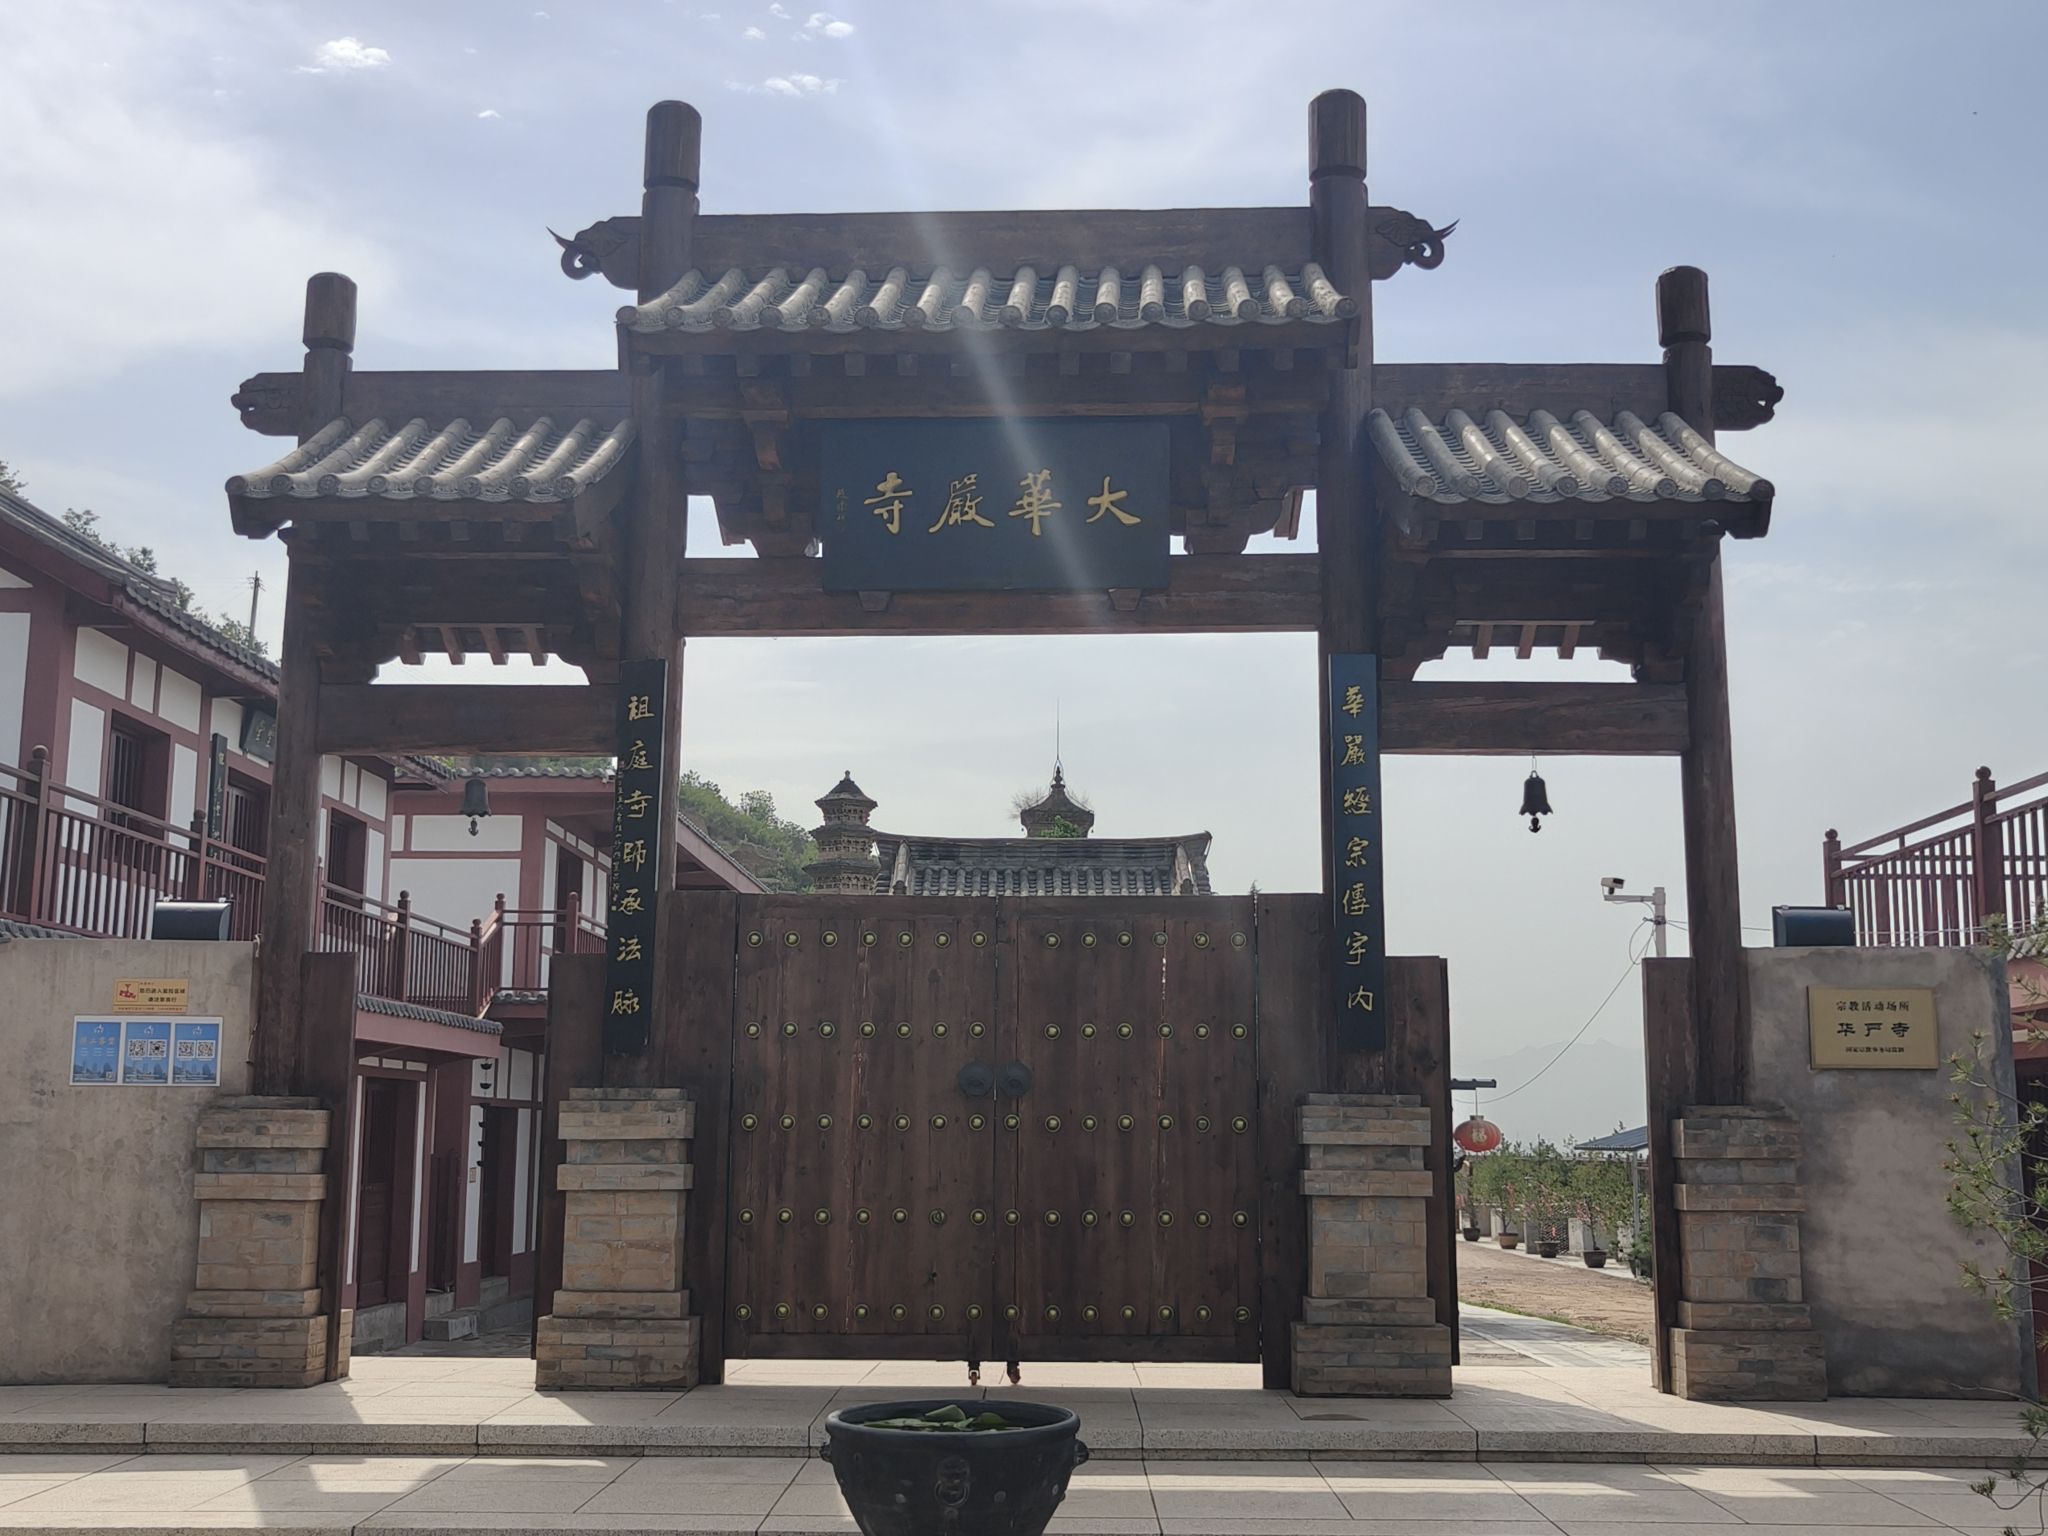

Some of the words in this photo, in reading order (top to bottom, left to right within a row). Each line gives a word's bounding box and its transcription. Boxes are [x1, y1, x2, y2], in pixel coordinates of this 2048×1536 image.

[1836, 1001, 1910, 1012] 宗教活动场所
